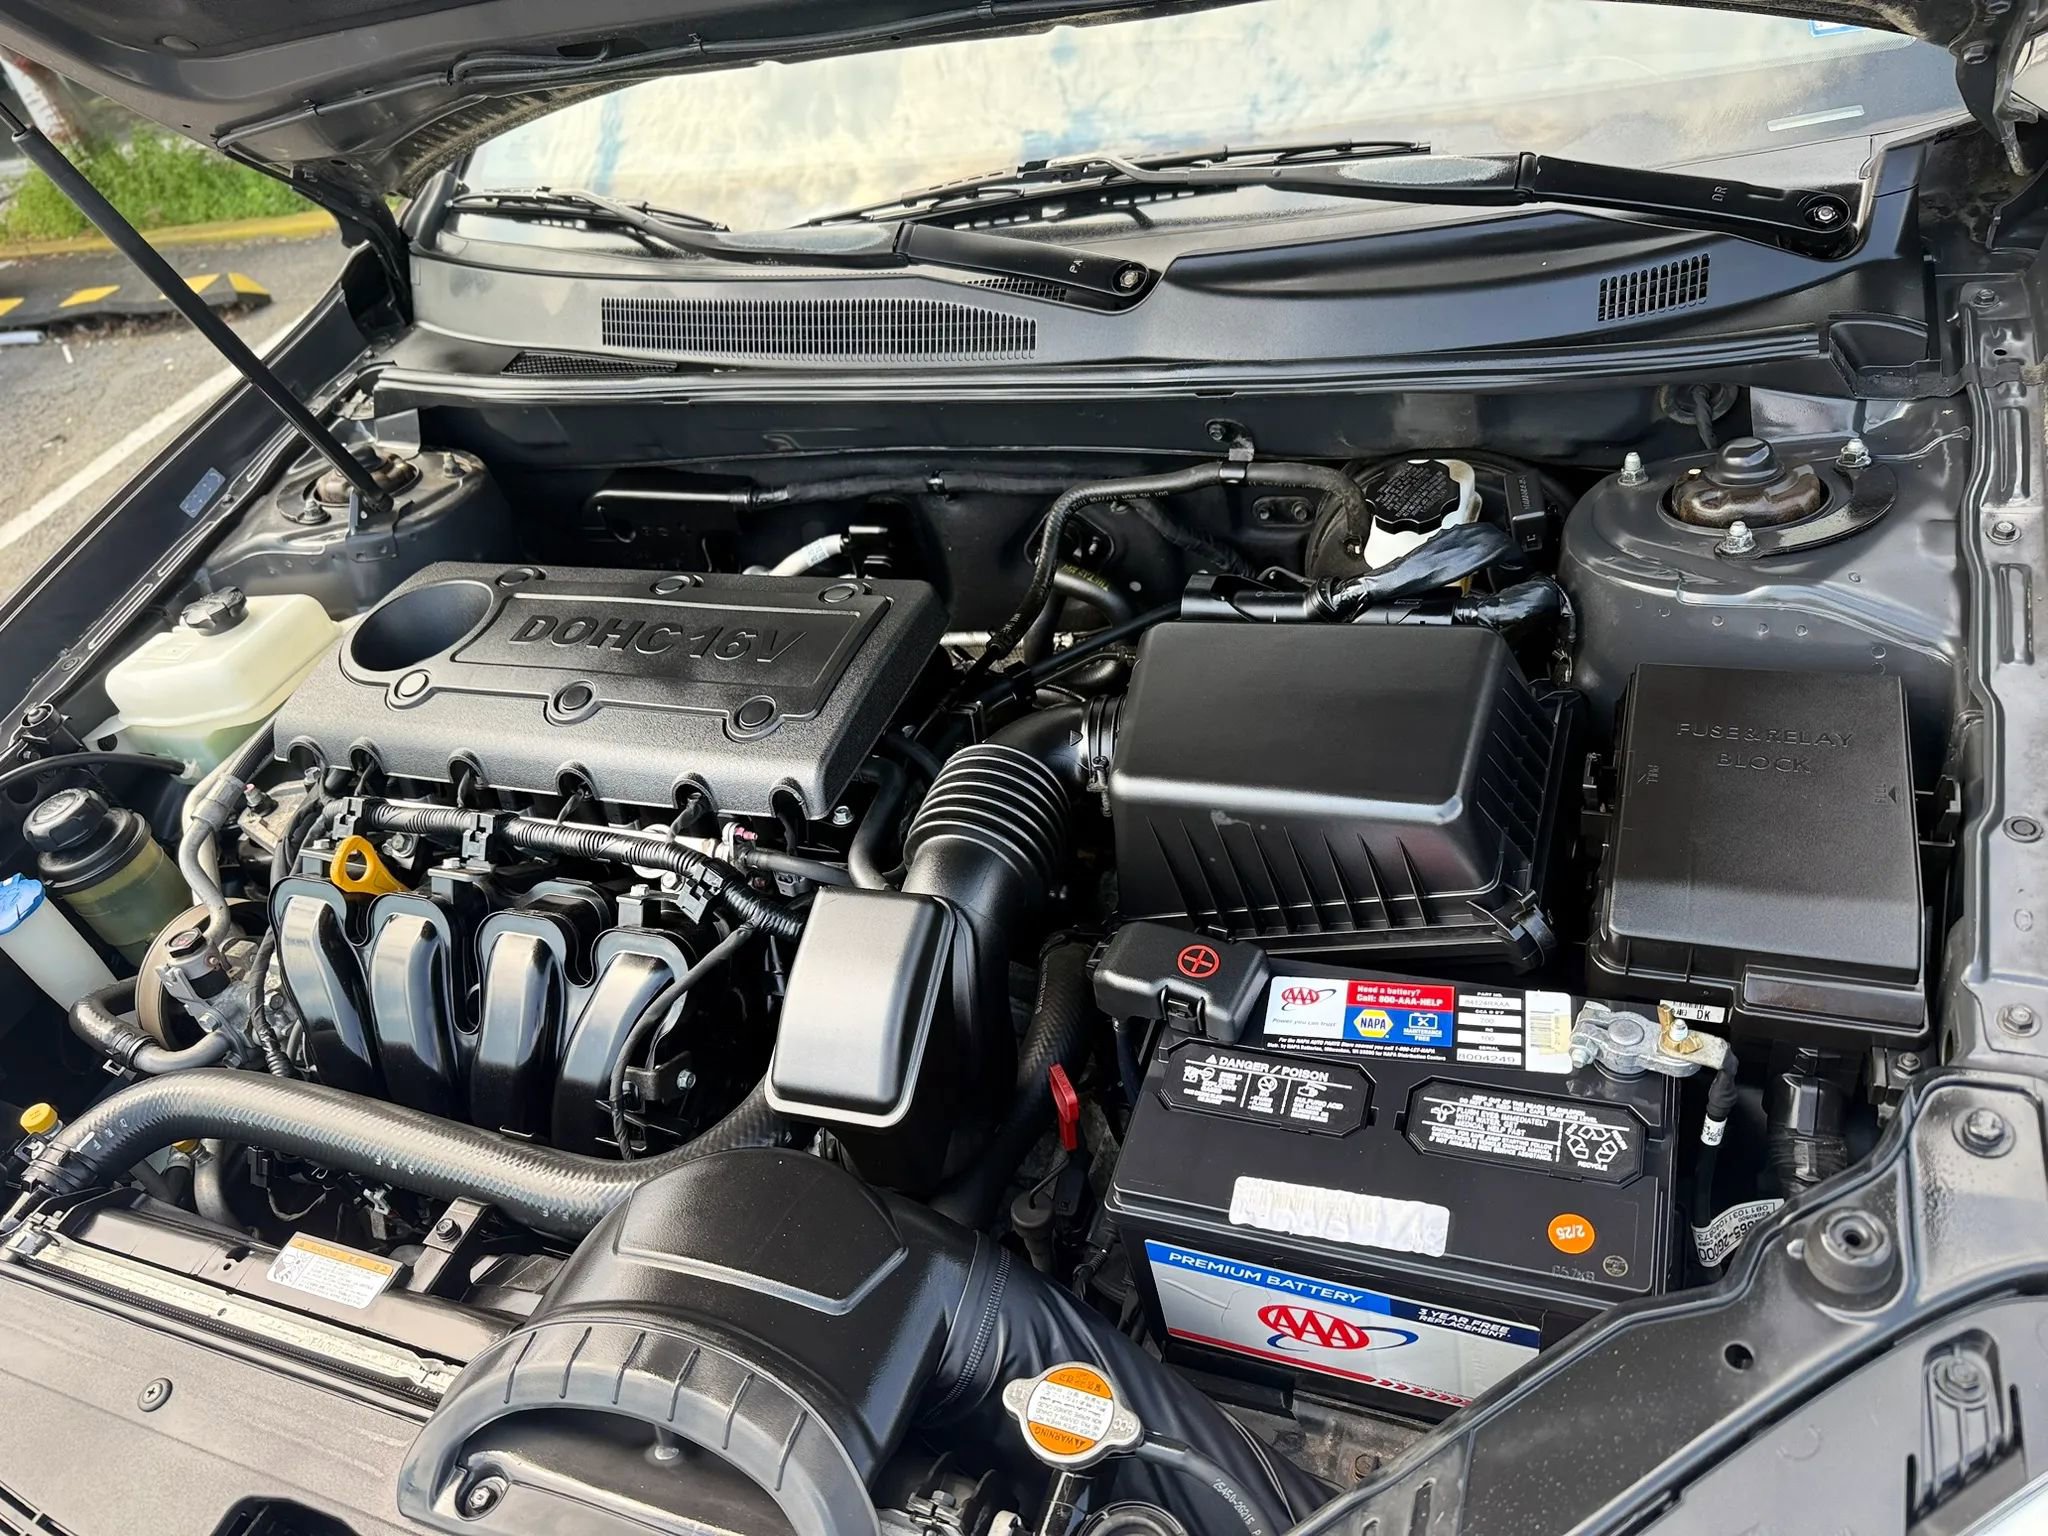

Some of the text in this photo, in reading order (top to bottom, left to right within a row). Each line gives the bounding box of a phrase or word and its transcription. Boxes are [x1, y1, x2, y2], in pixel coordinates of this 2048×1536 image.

[1711, 186, 1728, 202] DR
[509, 615, 808, 663] DOHC 16V
[1717, 752, 1811, 774] BLOCK
[1283, 987, 1318, 1005] AAA
[1357, 985, 1378, 994] Need
[1387, 987, 1421, 997] battery?
[1356, 995, 1443, 1007] Call: 800-AAA-HELP
[1360, 1017, 1386, 1029] NAPA
[1697, 1009, 1711, 1021] DK
[1219, 1056, 1269, 1073] DANGER
[1281, 1066, 1329, 1082] POISON
[1501, 1114, 1548, 1127] IMMEDIATELY
[1507, 1128, 1526, 1137] FAST
[1556, 1223, 1586, 1240] 2/25
[1169, 1252, 1364, 1303] PREMIUM BATTERY
[1266, 1306, 1361, 1349] AAA
[1418, 1308, 1510, 1334] 3 YEAR FREE
[1034, 1426, 1074, 1445] WARNING
[1212, 1478, 1256, 1526] 25450-2G215
